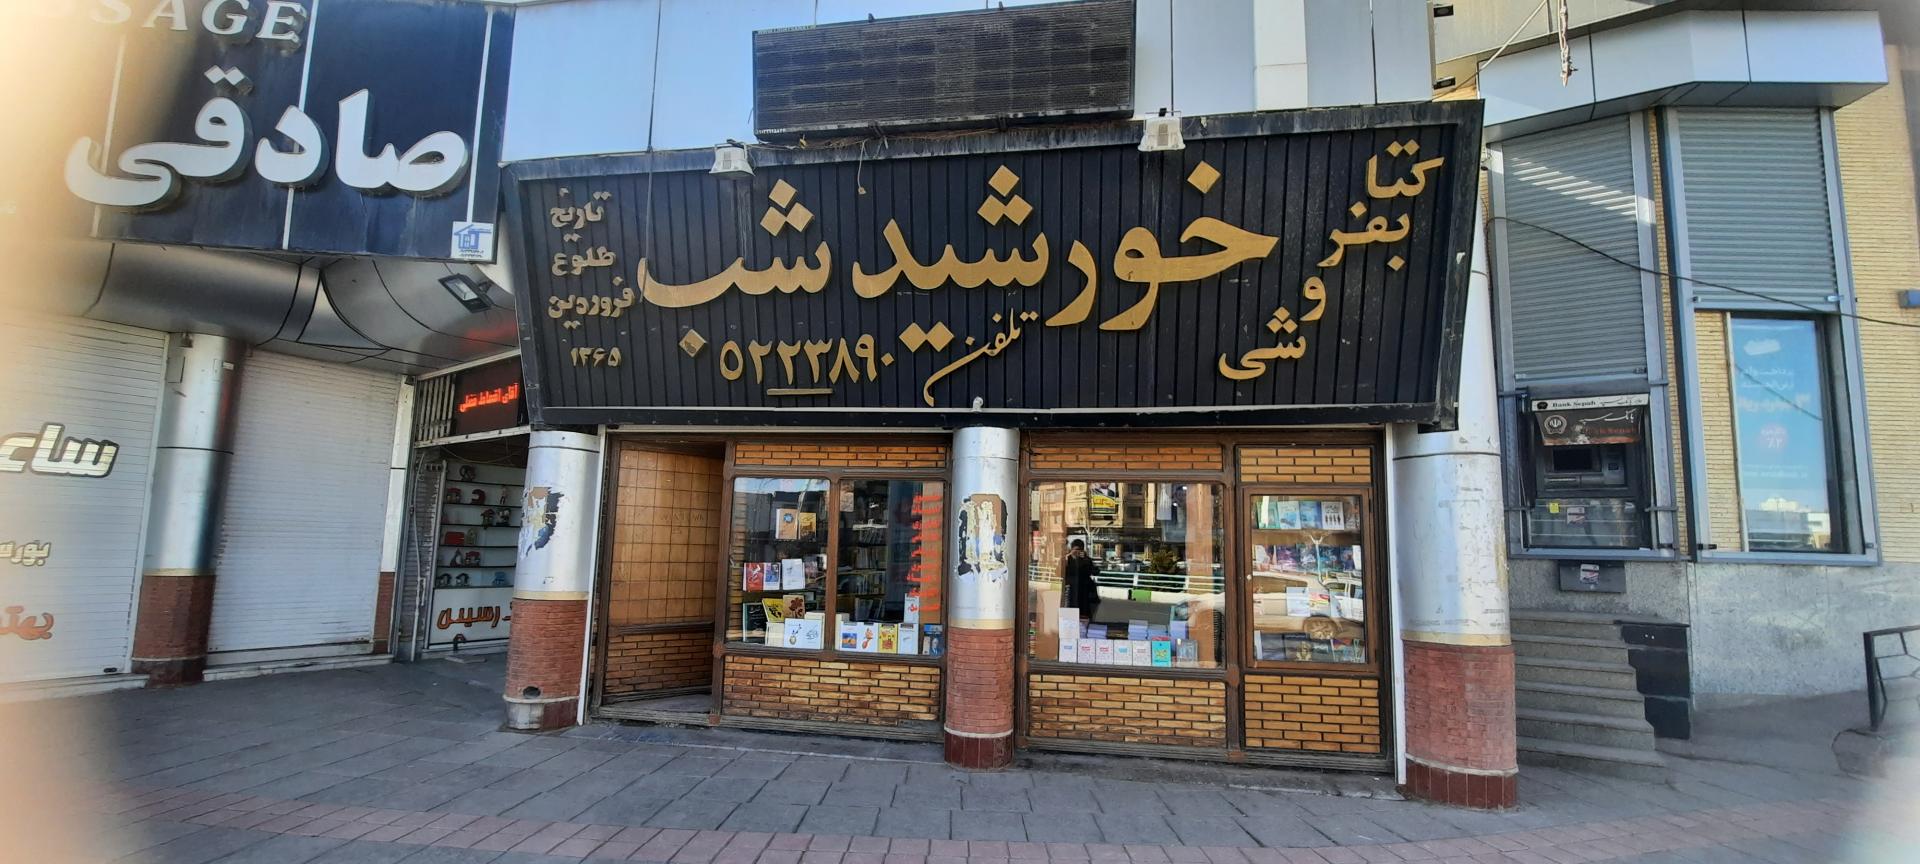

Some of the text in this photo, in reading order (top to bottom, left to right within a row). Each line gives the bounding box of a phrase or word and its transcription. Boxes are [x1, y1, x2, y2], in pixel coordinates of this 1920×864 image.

[64, 64, 470, 207] صادقی
[550, 187, 612, 242] تاریخ
[552, 246, 616, 276] طلوع
[637, 160, 1281, 357] خورشید شب
[548, 276, 635, 329] فروردین
[571, 347, 621, 367] ۱۳۶۵
[923, 307, 1039, 407] تلفن
[1605, 408, 1637, 423] بانک
